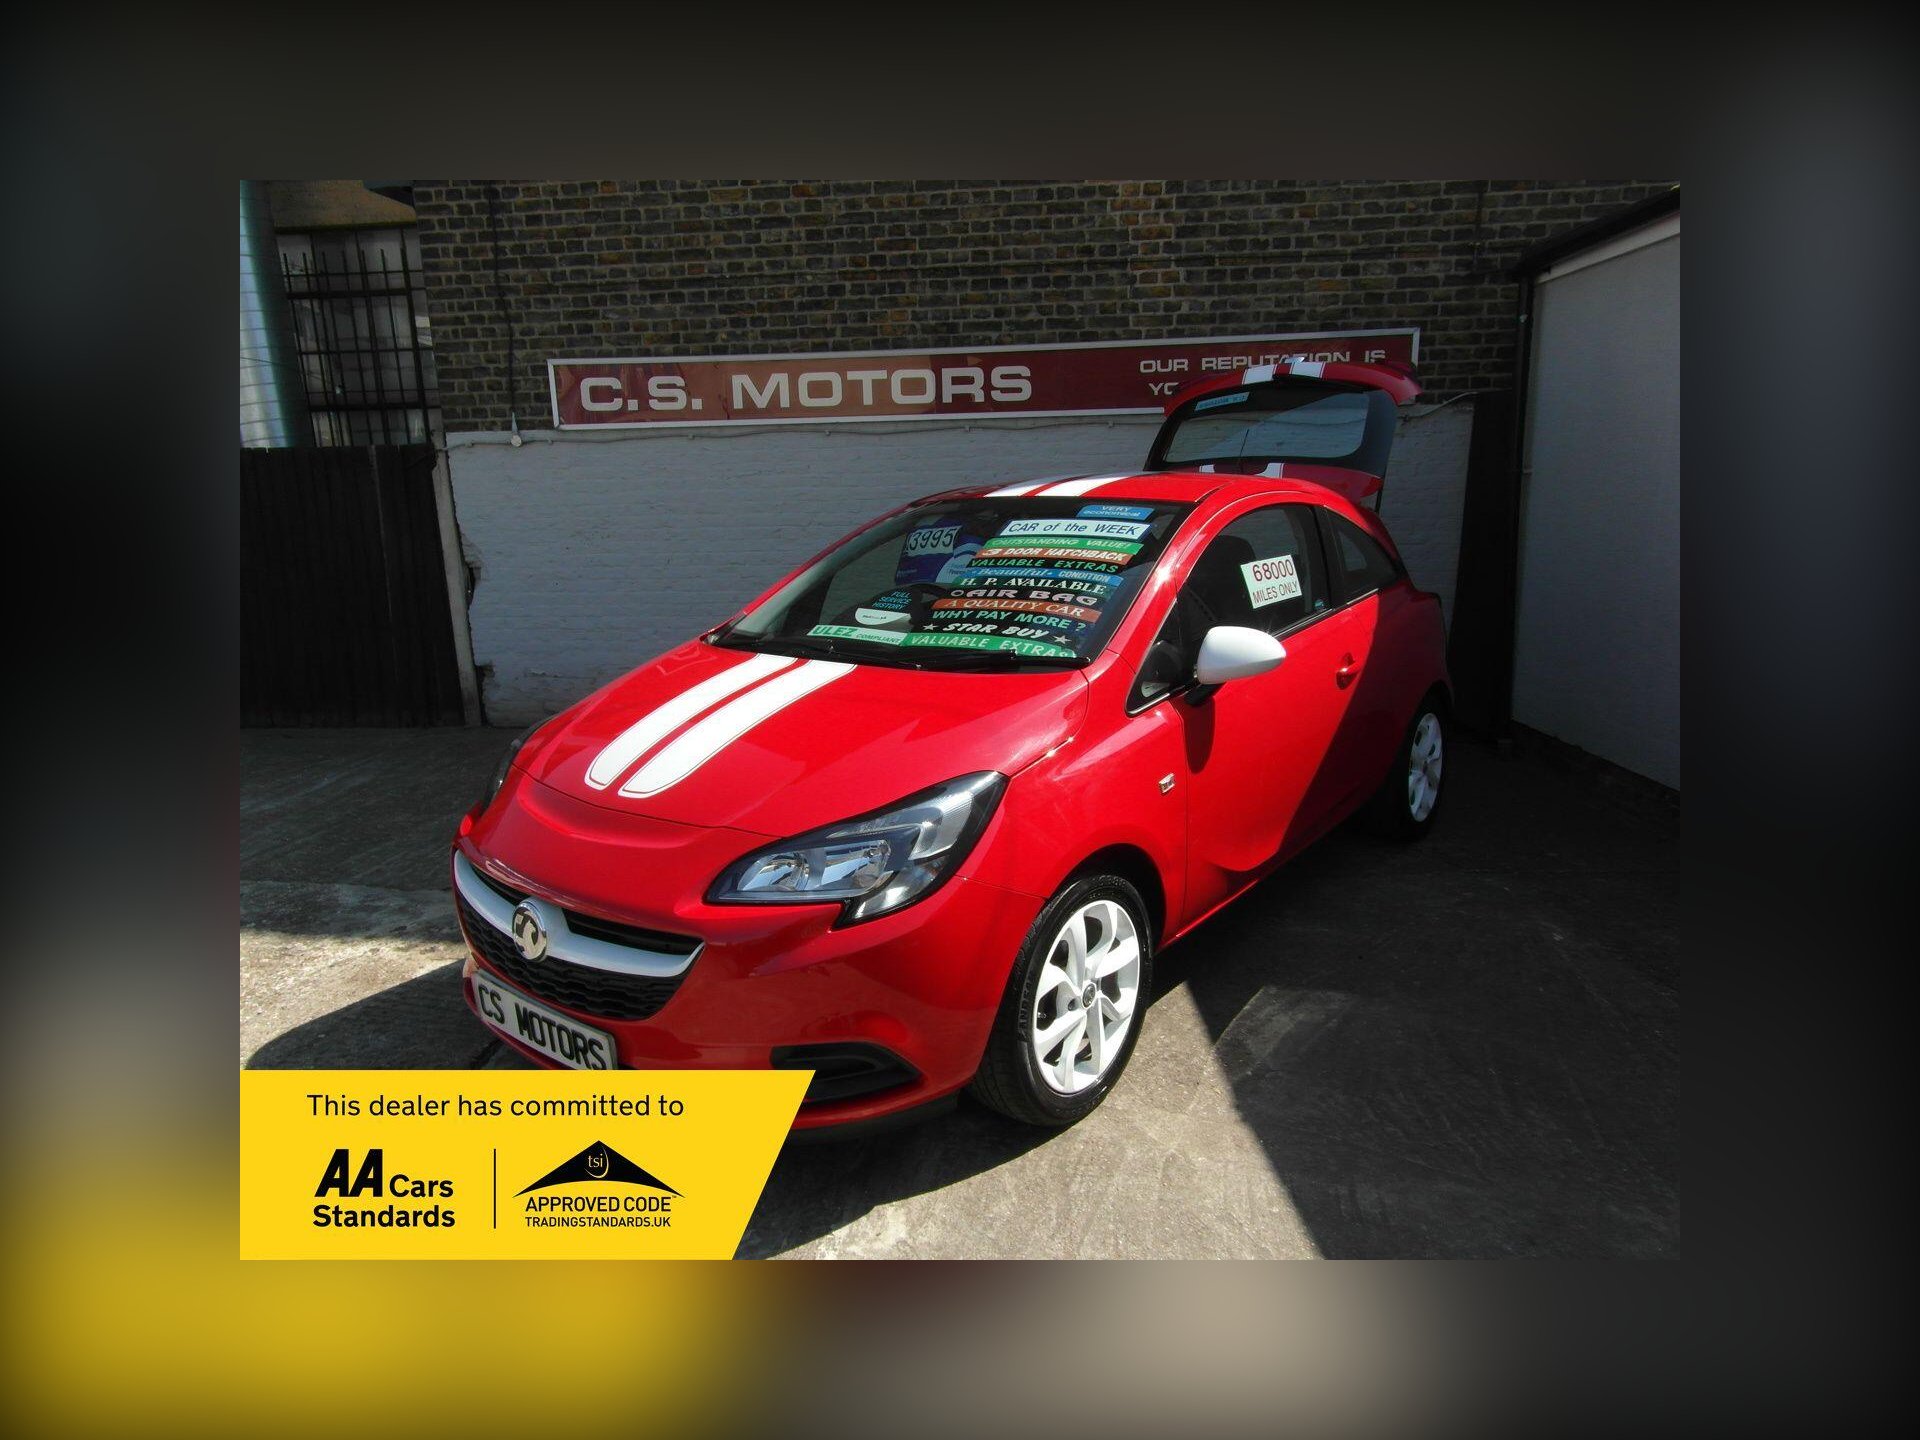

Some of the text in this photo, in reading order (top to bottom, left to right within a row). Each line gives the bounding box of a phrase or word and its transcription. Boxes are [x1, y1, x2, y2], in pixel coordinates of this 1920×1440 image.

[1140, 358, 1189, 374] OUR
[580, 365, 1032, 412] C.S. MOTORS
[1008, 522, 1141, 536] CAR of the WEEK
[908, 528, 957, 551] 3995
[992, 537, 1080, 547] OUTSTANDING
[1006, 548, 1043, 557] DOOR
[1045, 548, 1129, 561] HATCHBACK
[970, 558, 1119, 574] VALUABLE EXTRAS
[1252, 559, 1294, 582] 68000
[1058, 570, 1111, 582] CONDITION
[960, 577, 1107, 595] H. P. AVAILABLE
[1253, 581, 1297, 604] MILES ONLY
[879, 596, 912, 605] SERVICE
[966, 589, 1098, 606] AIR BAG
[871, 602, 906, 610] HISTORY
[944, 600, 1085, 618] A QUALITY CAR
[932, 611, 1087, 632] WHY PAY MORE ?
[811, 626, 859, 637] ULEZ
[855, 633, 901, 644] COMPLIANT
[942, 623, 1049, 639] STAR BUY
[911, 634, 990, 648] VALUABLE
[478, 984, 607, 1070] CS MOTORS
